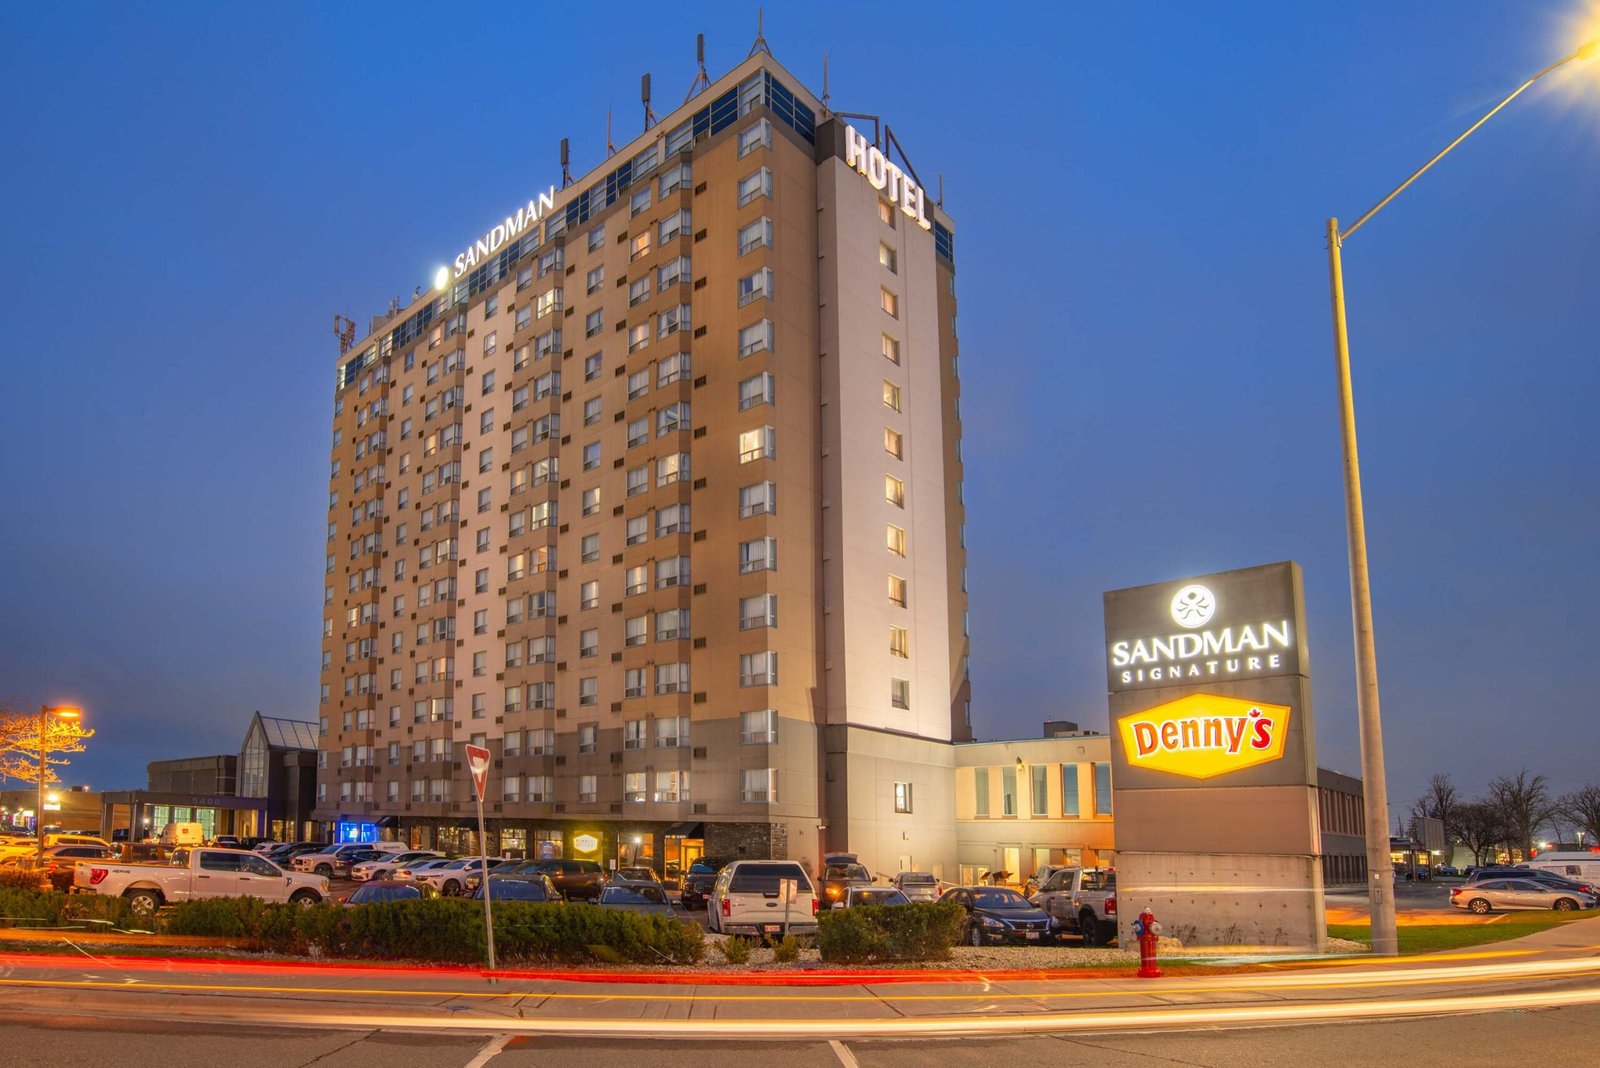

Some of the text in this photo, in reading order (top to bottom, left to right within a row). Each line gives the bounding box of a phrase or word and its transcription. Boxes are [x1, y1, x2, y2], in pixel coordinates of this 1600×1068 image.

[844, 124, 932, 231] HOTEL
[453, 186, 555, 279] SANDMAN
[1112, 620, 1290, 667] SANDMAN
[1122, 654, 1281, 684] SIGNATURE
[1133, 708, 1275, 756] Denny's
